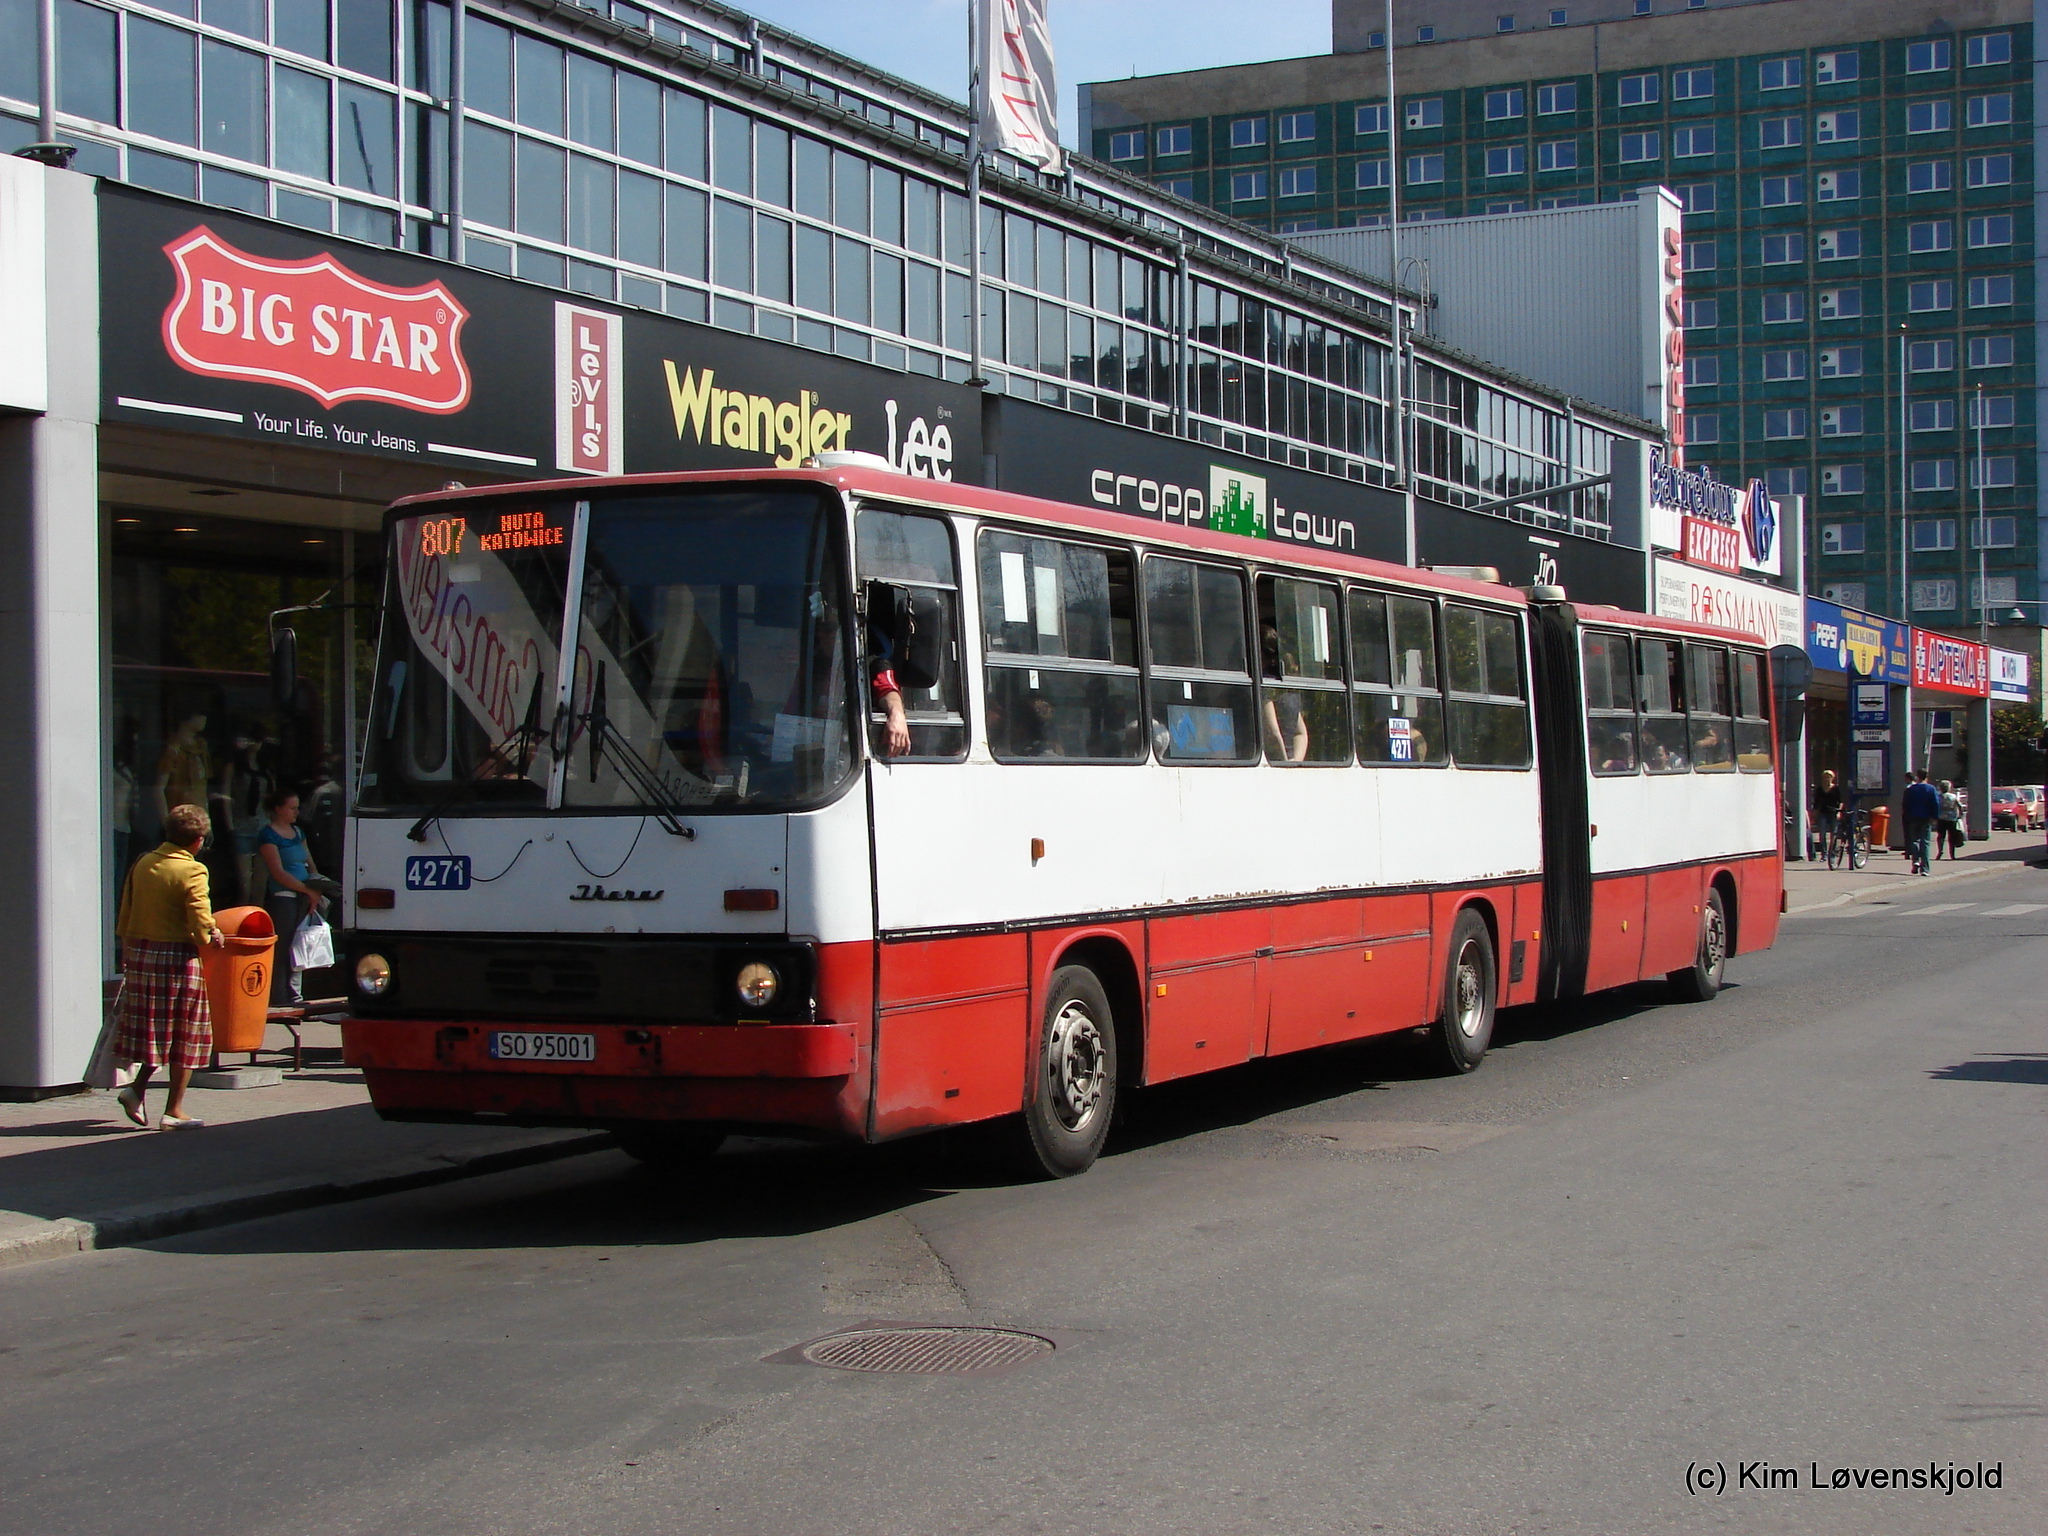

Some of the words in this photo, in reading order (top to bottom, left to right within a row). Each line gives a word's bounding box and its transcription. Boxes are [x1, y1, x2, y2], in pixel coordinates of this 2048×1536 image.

[201, 278, 295, 347] BIG
[311, 304, 441, 376] STAR
[254, 412, 292, 435] Your
[296, 418, 328, 441] Life.
[333, 424, 369, 446] Your
[371, 430, 421, 454] Jeans.
[663, 359, 851, 469] Wrangler
[884, 400, 952, 482] Lee
[1650, 447, 1738, 524] Carrefour
[501, 512, 545, 532] HUTA
[1091, 468, 1204, 526] cropp
[1273, 497, 1356, 550] town
[422, 517, 467, 556] 807
[480, 527, 564, 551] KATOWICE
[1689, 522, 1738, 570] EXPRESS
[1691, 583, 1779, 643] ROSSMANN
[1927, 638, 1976, 689] APTEKA
[1391, 739, 1412, 759] 4271
[407, 860, 466, 887] 4271
[569, 884, 665, 902] Ikarus
[501, 1034, 527, 1056] SO
[533, 1035, 590, 1059] 95001
